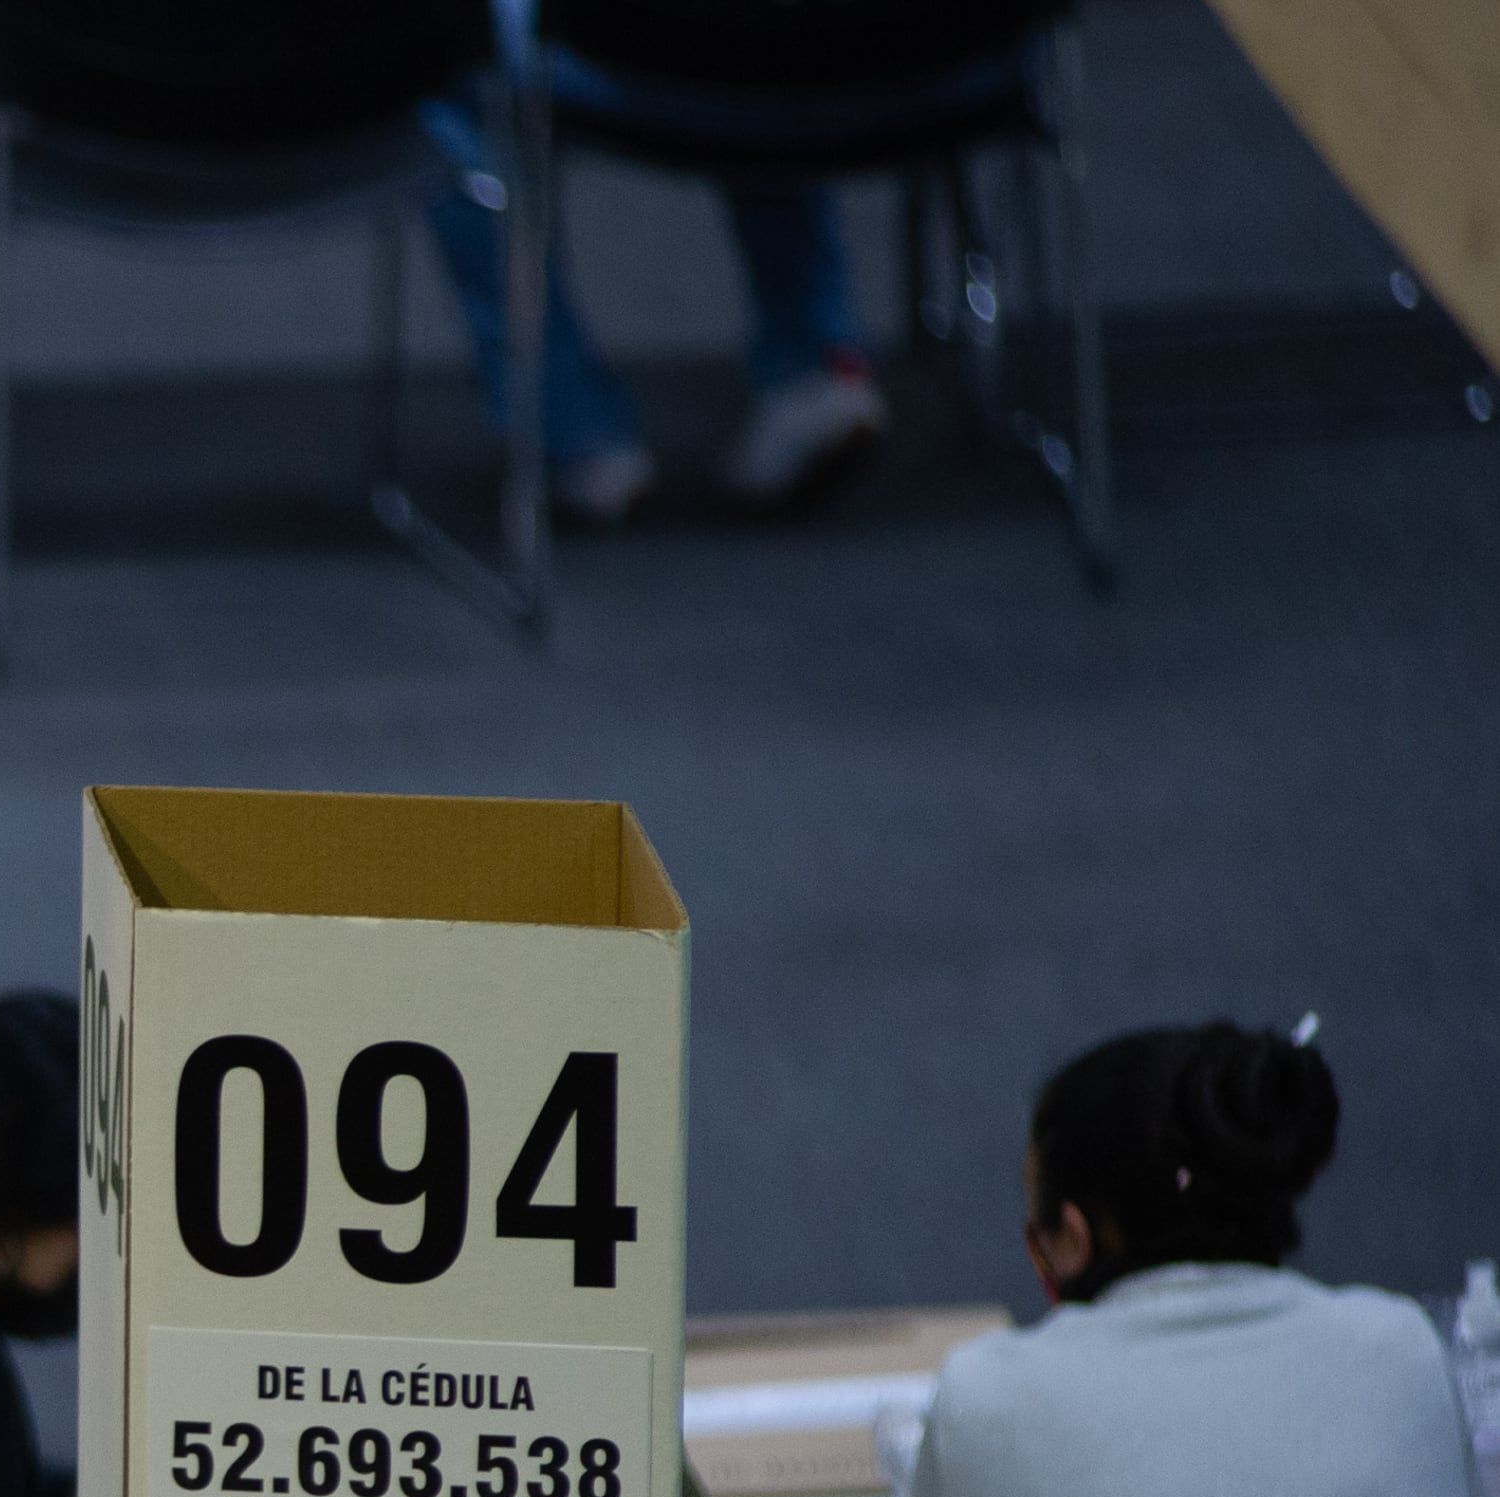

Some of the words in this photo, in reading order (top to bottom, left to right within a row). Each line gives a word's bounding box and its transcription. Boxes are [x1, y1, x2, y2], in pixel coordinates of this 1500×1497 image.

[84, 933, 125, 1258] 094
[171, 1034, 638, 1289] 094
[257, 1365, 305, 1401] DE
[321, 1368, 366, 1404] LA
[382, 1363, 535, 1412] CÉDULA
